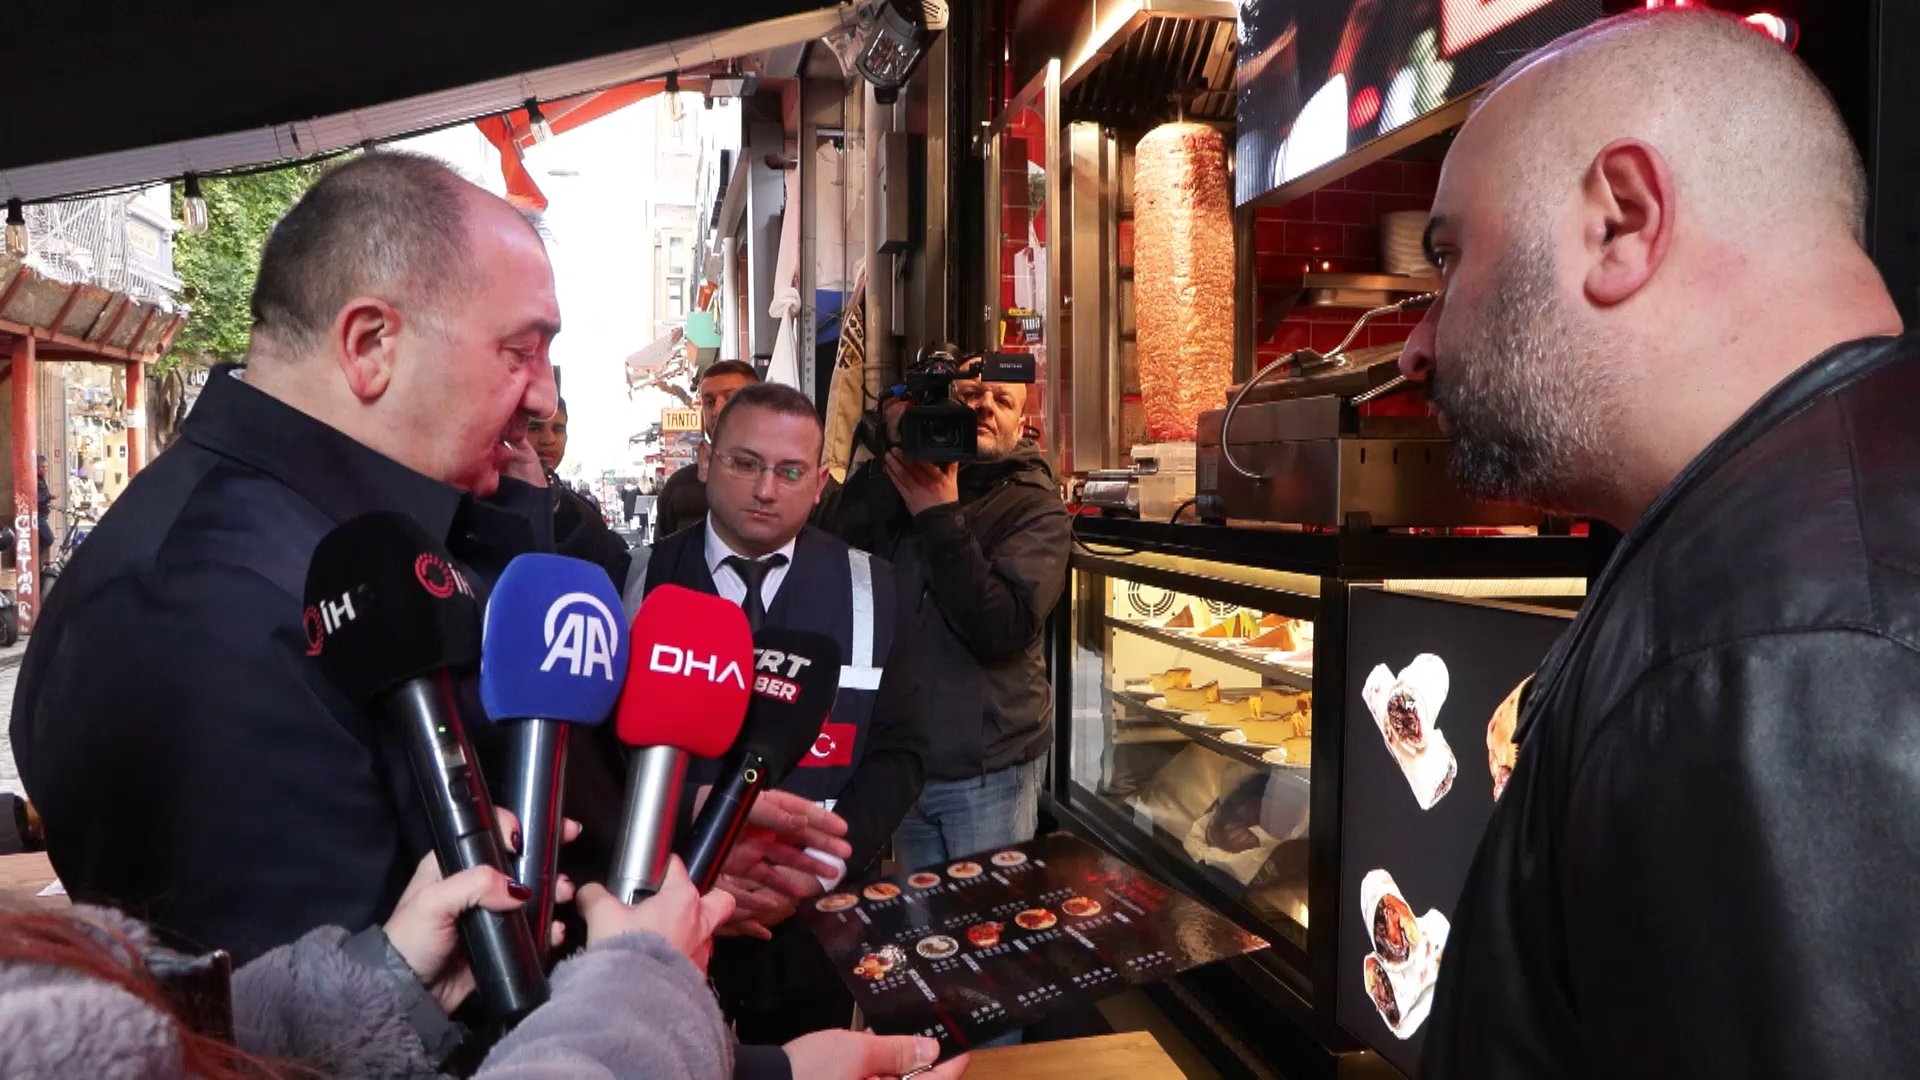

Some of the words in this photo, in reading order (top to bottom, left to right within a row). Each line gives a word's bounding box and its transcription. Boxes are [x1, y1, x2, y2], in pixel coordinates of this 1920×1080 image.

[448, 562, 476, 599] İH
[320, 588, 358, 635] İH
[540, 613, 613, 682] AA
[650, 643, 746, 690] DHA
[754, 676, 796, 701] BER
